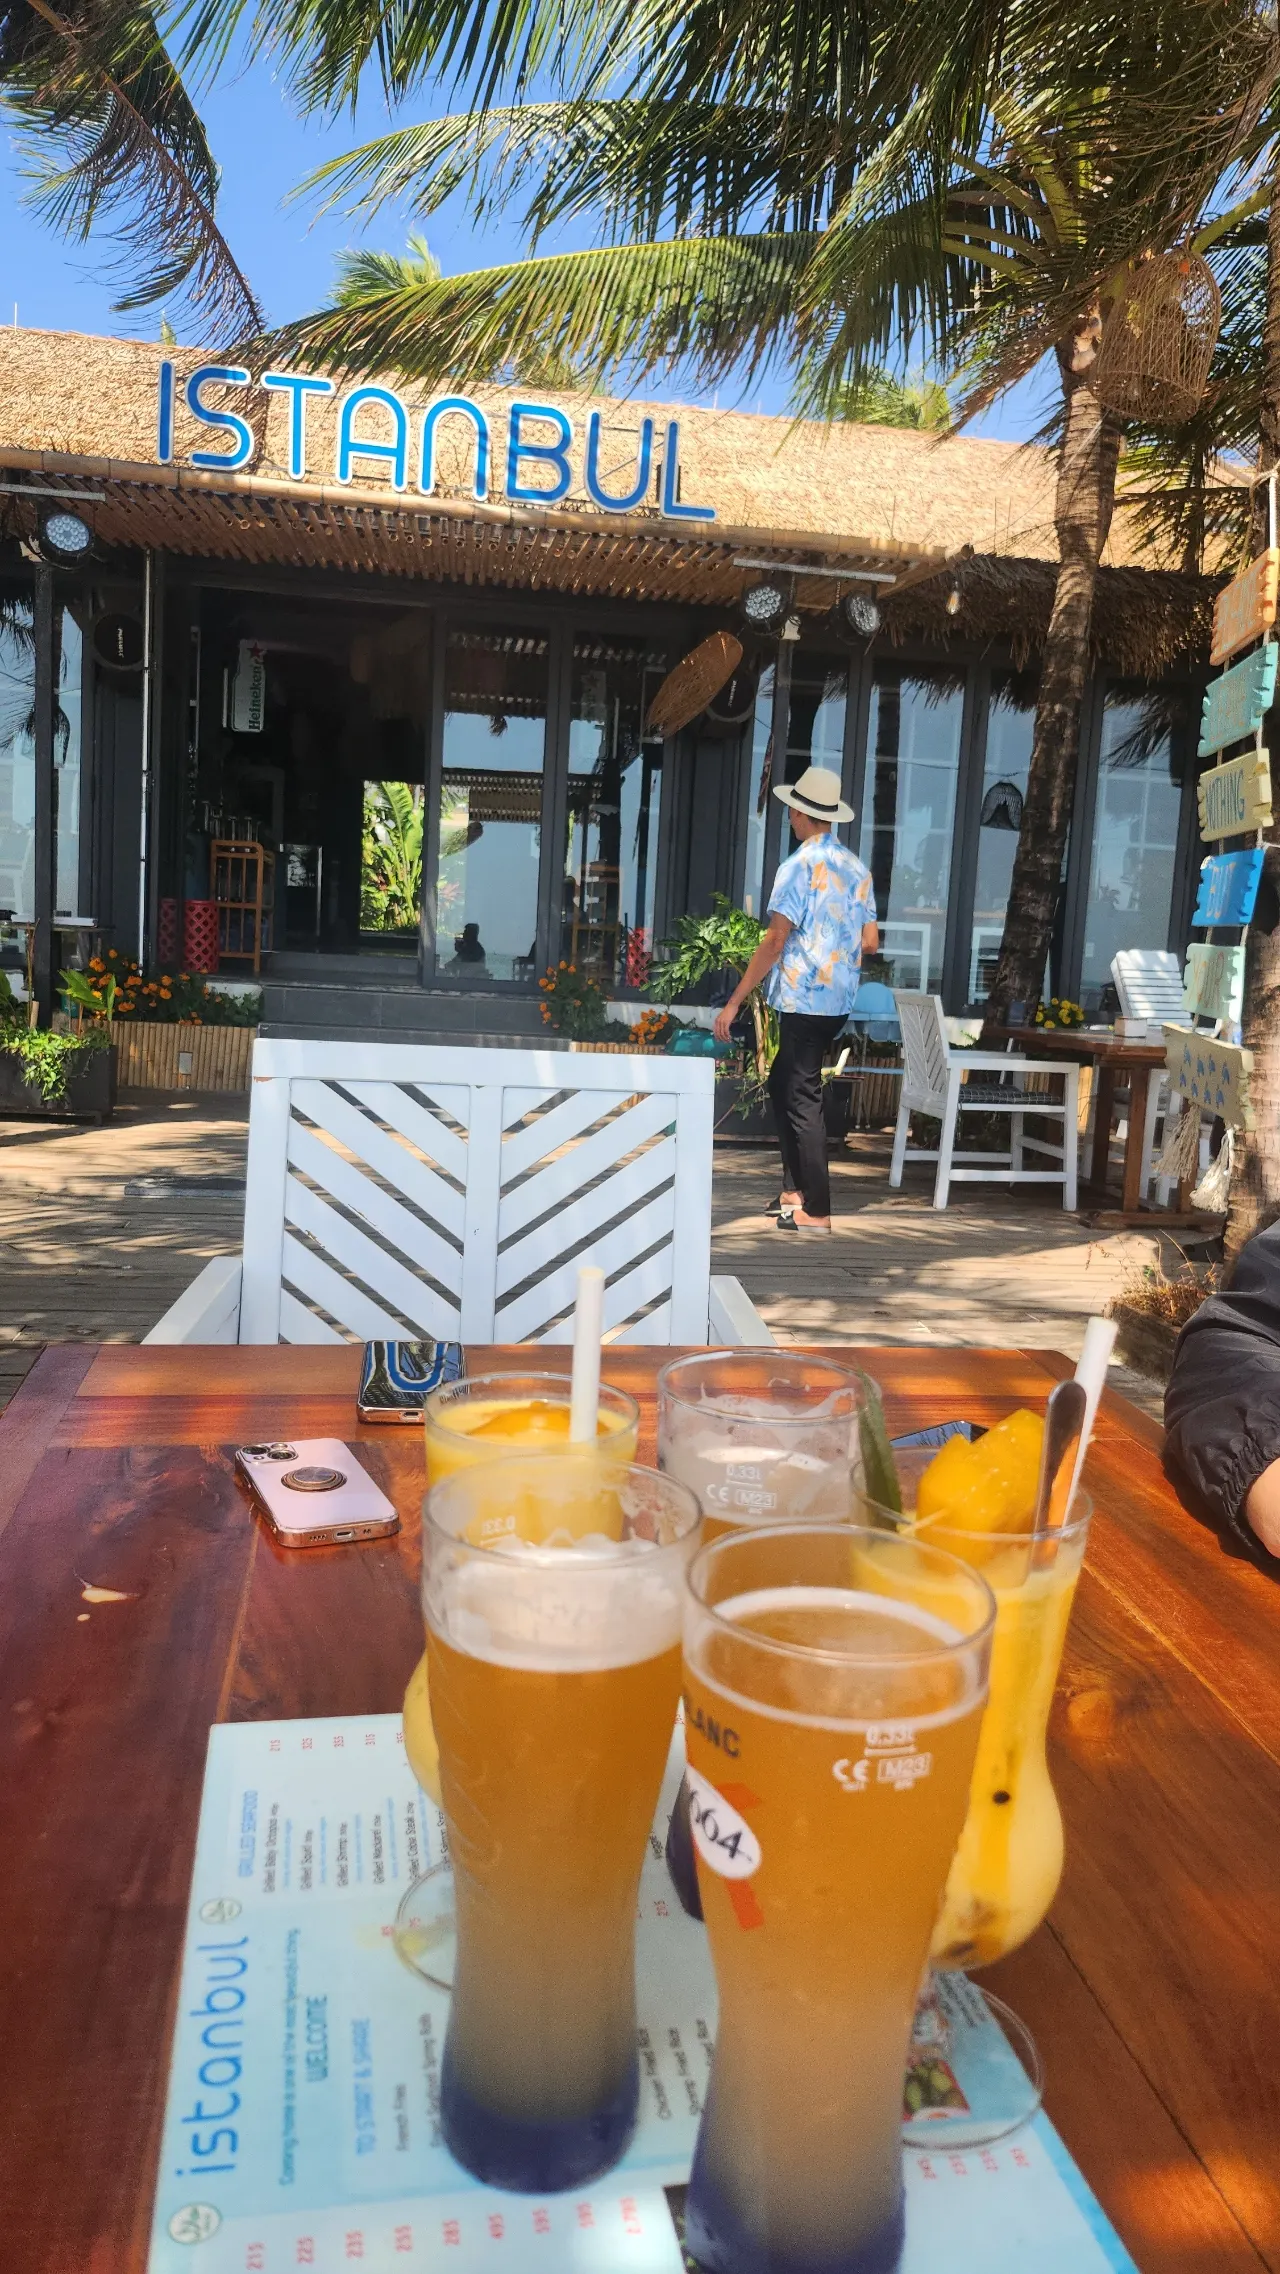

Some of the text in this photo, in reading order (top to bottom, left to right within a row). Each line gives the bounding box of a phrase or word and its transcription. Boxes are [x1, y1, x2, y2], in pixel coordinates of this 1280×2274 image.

[157, 359, 717, 522] ISTANBUL
[248, 666, 262, 730] Heineken
[175, 1936, 249, 2177] istanbul
[304, 1995, 328, 2083] WELCOME
